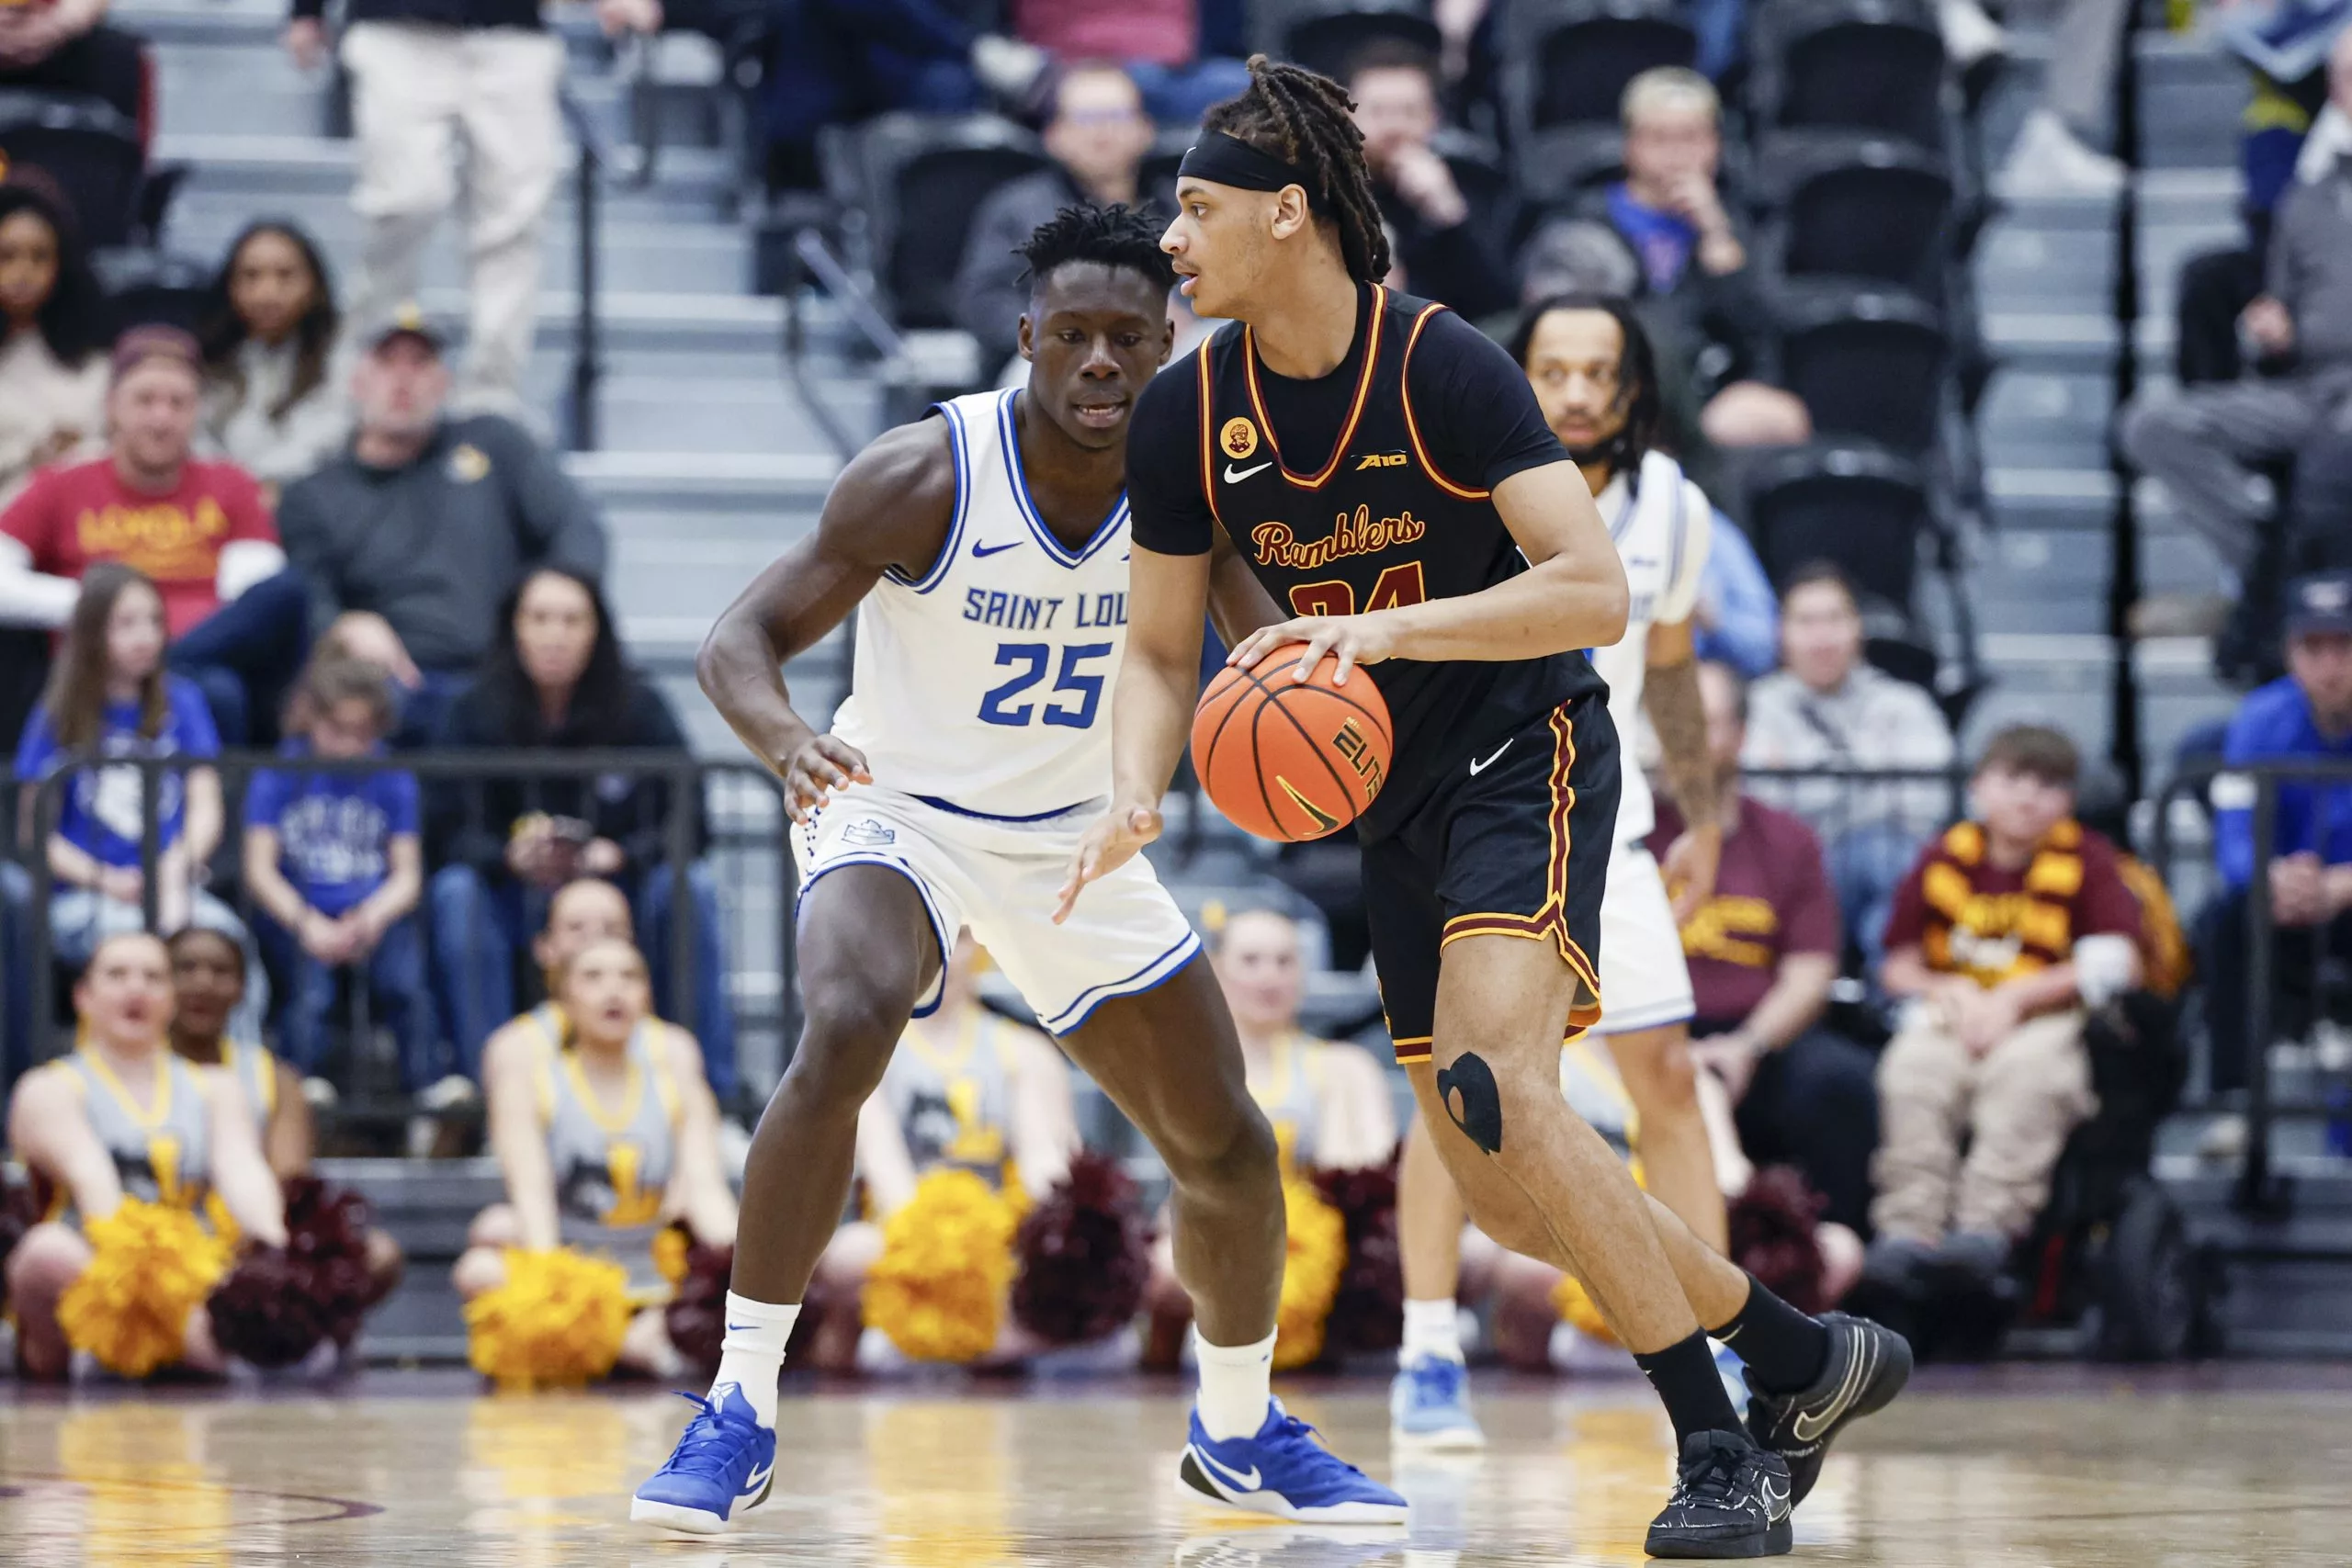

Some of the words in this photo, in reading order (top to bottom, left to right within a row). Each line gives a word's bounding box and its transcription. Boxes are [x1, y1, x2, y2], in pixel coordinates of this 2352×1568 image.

[1251, 503, 1425, 570] Ramblers
[963, 586, 1064, 629] SAINT
[1075, 592, 1128, 628] LOU
[978, 641, 1114, 728] 25
